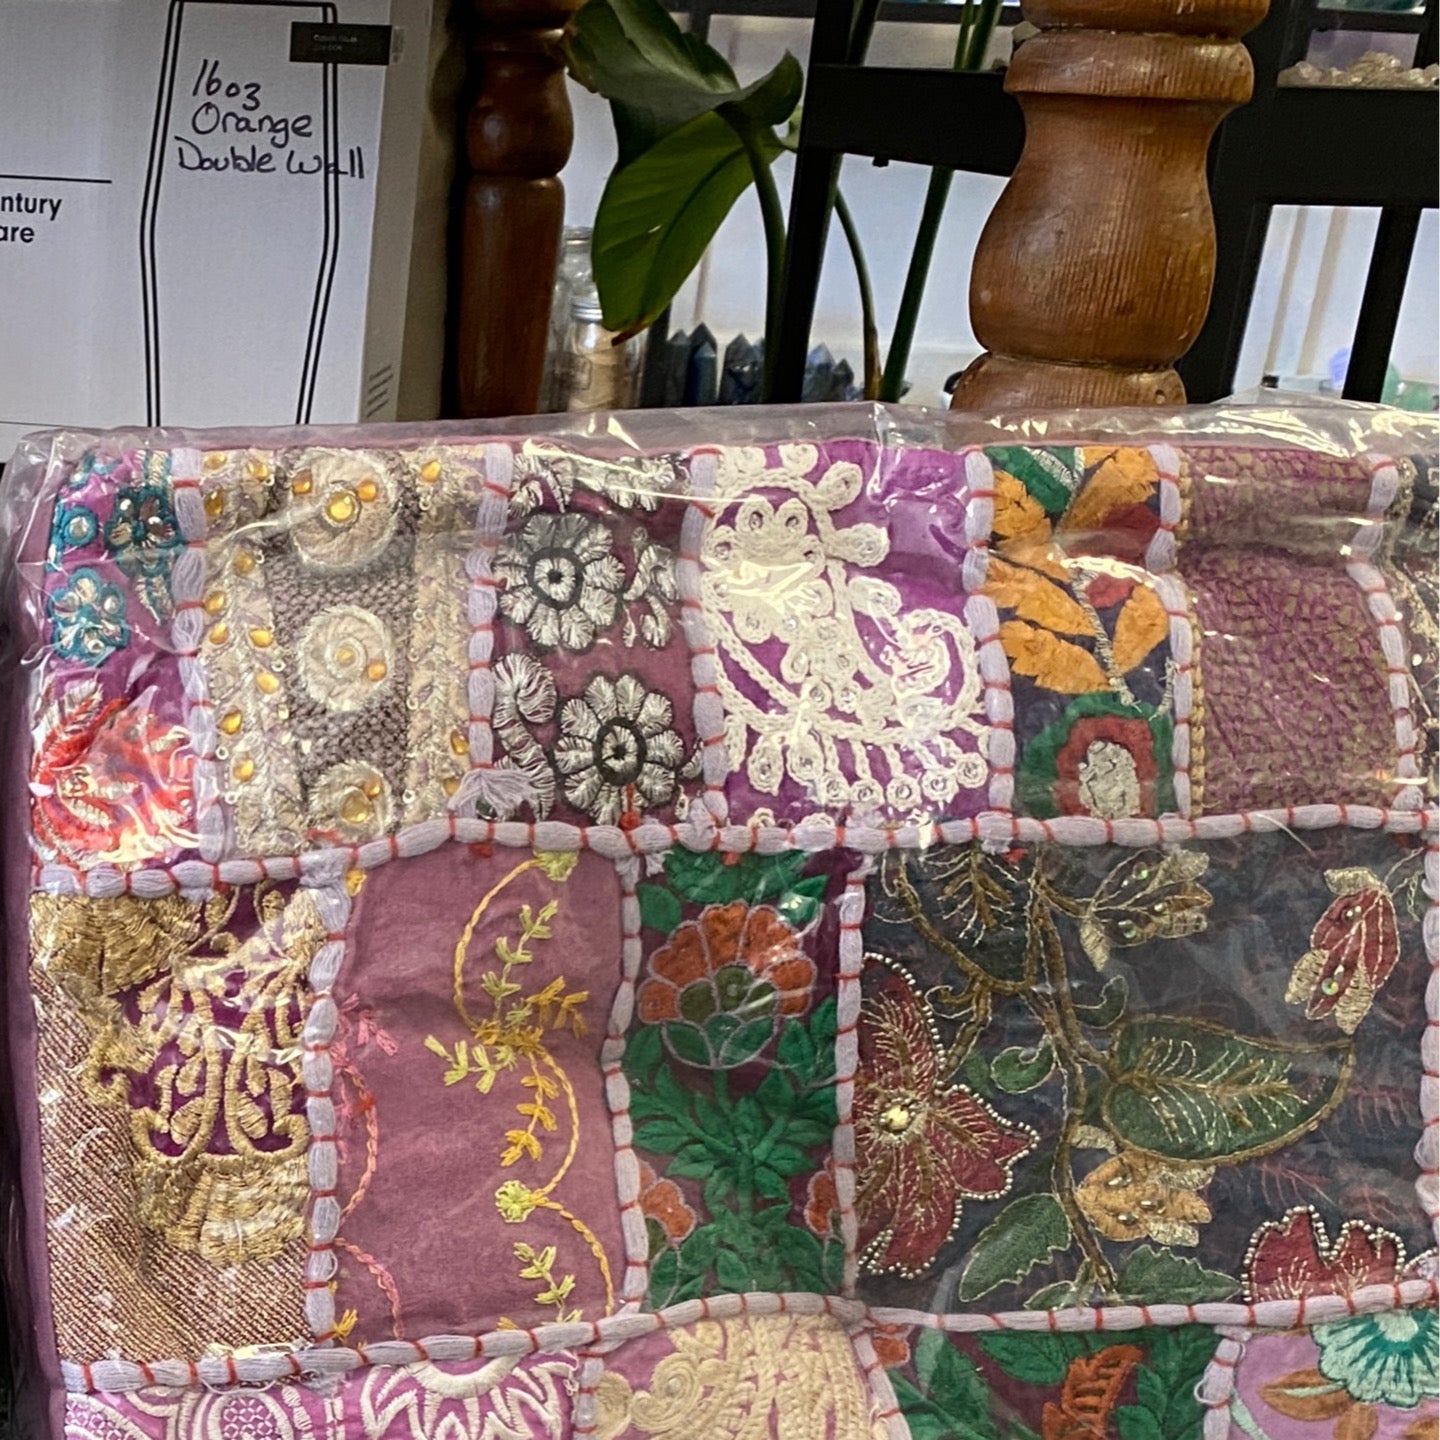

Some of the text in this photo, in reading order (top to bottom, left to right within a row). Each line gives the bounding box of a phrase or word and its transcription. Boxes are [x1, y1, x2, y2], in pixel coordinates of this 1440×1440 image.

[192, 101, 313, 149] Orange
[174, 135, 365, 179] Double Wall
